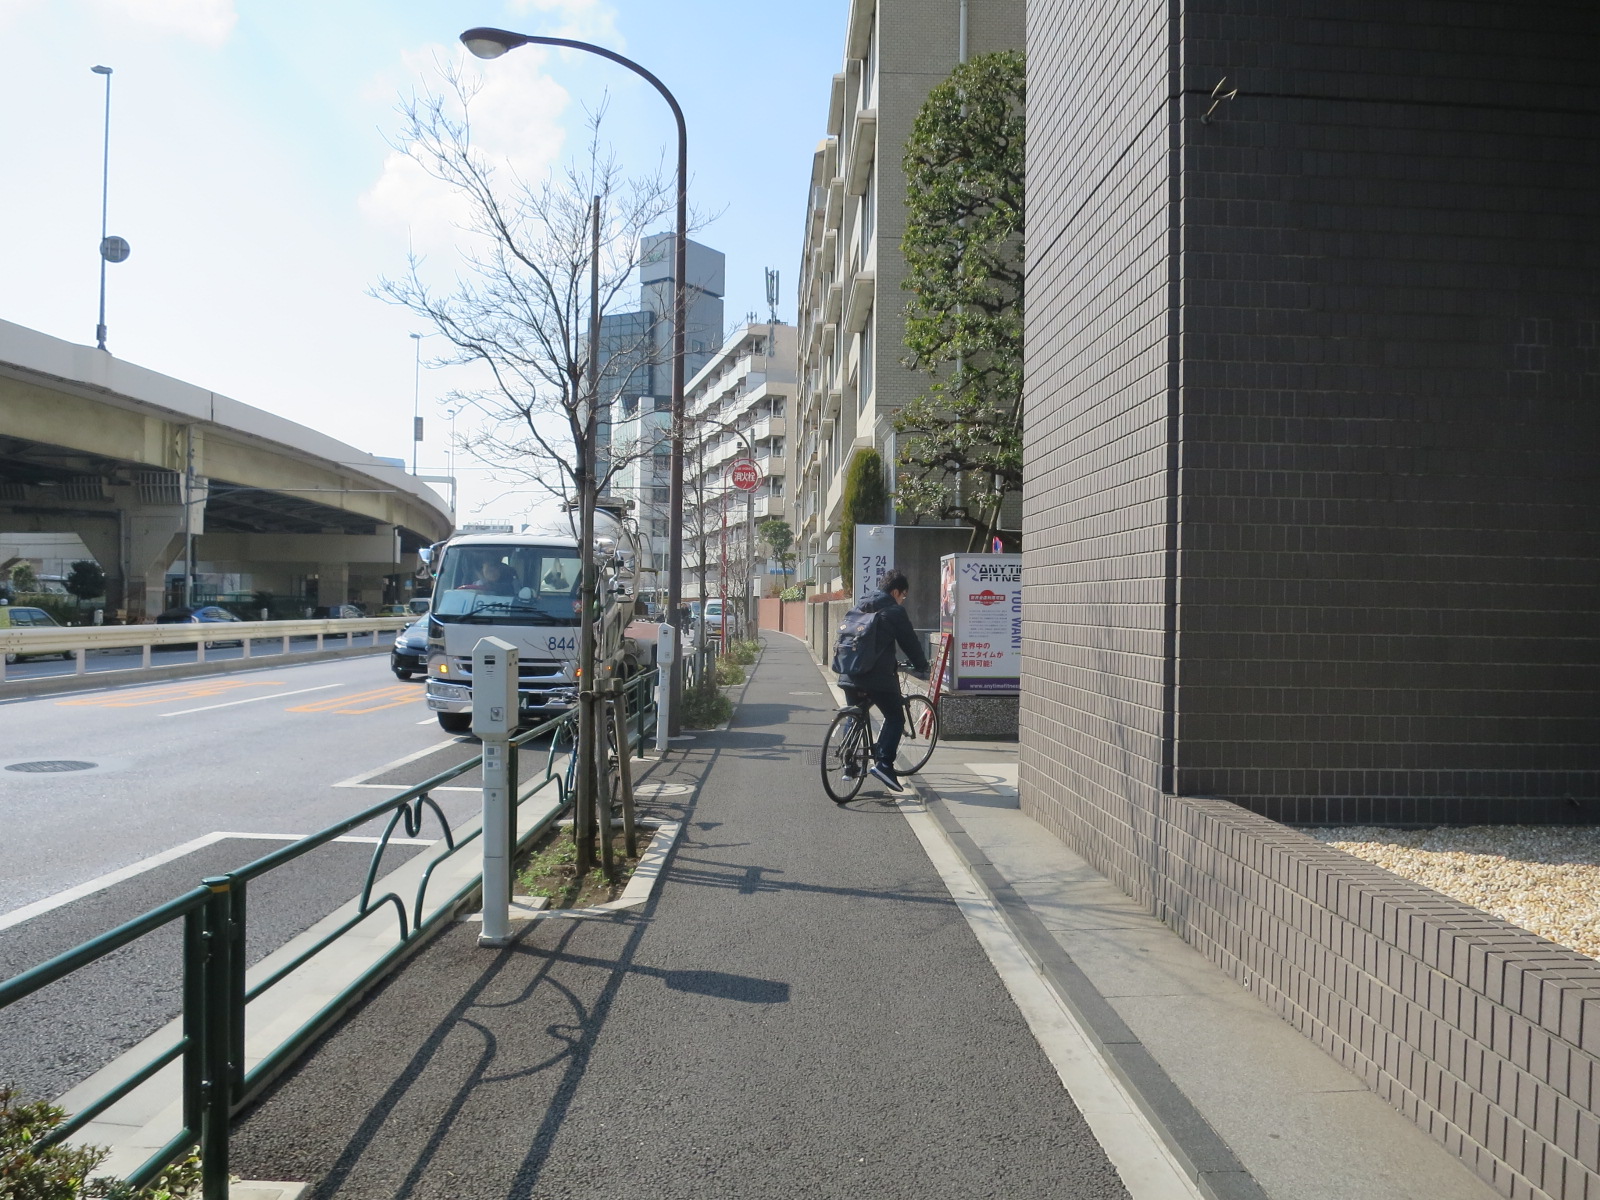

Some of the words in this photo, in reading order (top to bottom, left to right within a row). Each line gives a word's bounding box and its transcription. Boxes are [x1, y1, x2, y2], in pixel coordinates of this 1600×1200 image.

[734, 471, 756, 482] 消火栓
[548, 636, 575, 651] 844
[961, 642, 991, 650] 世界中の
